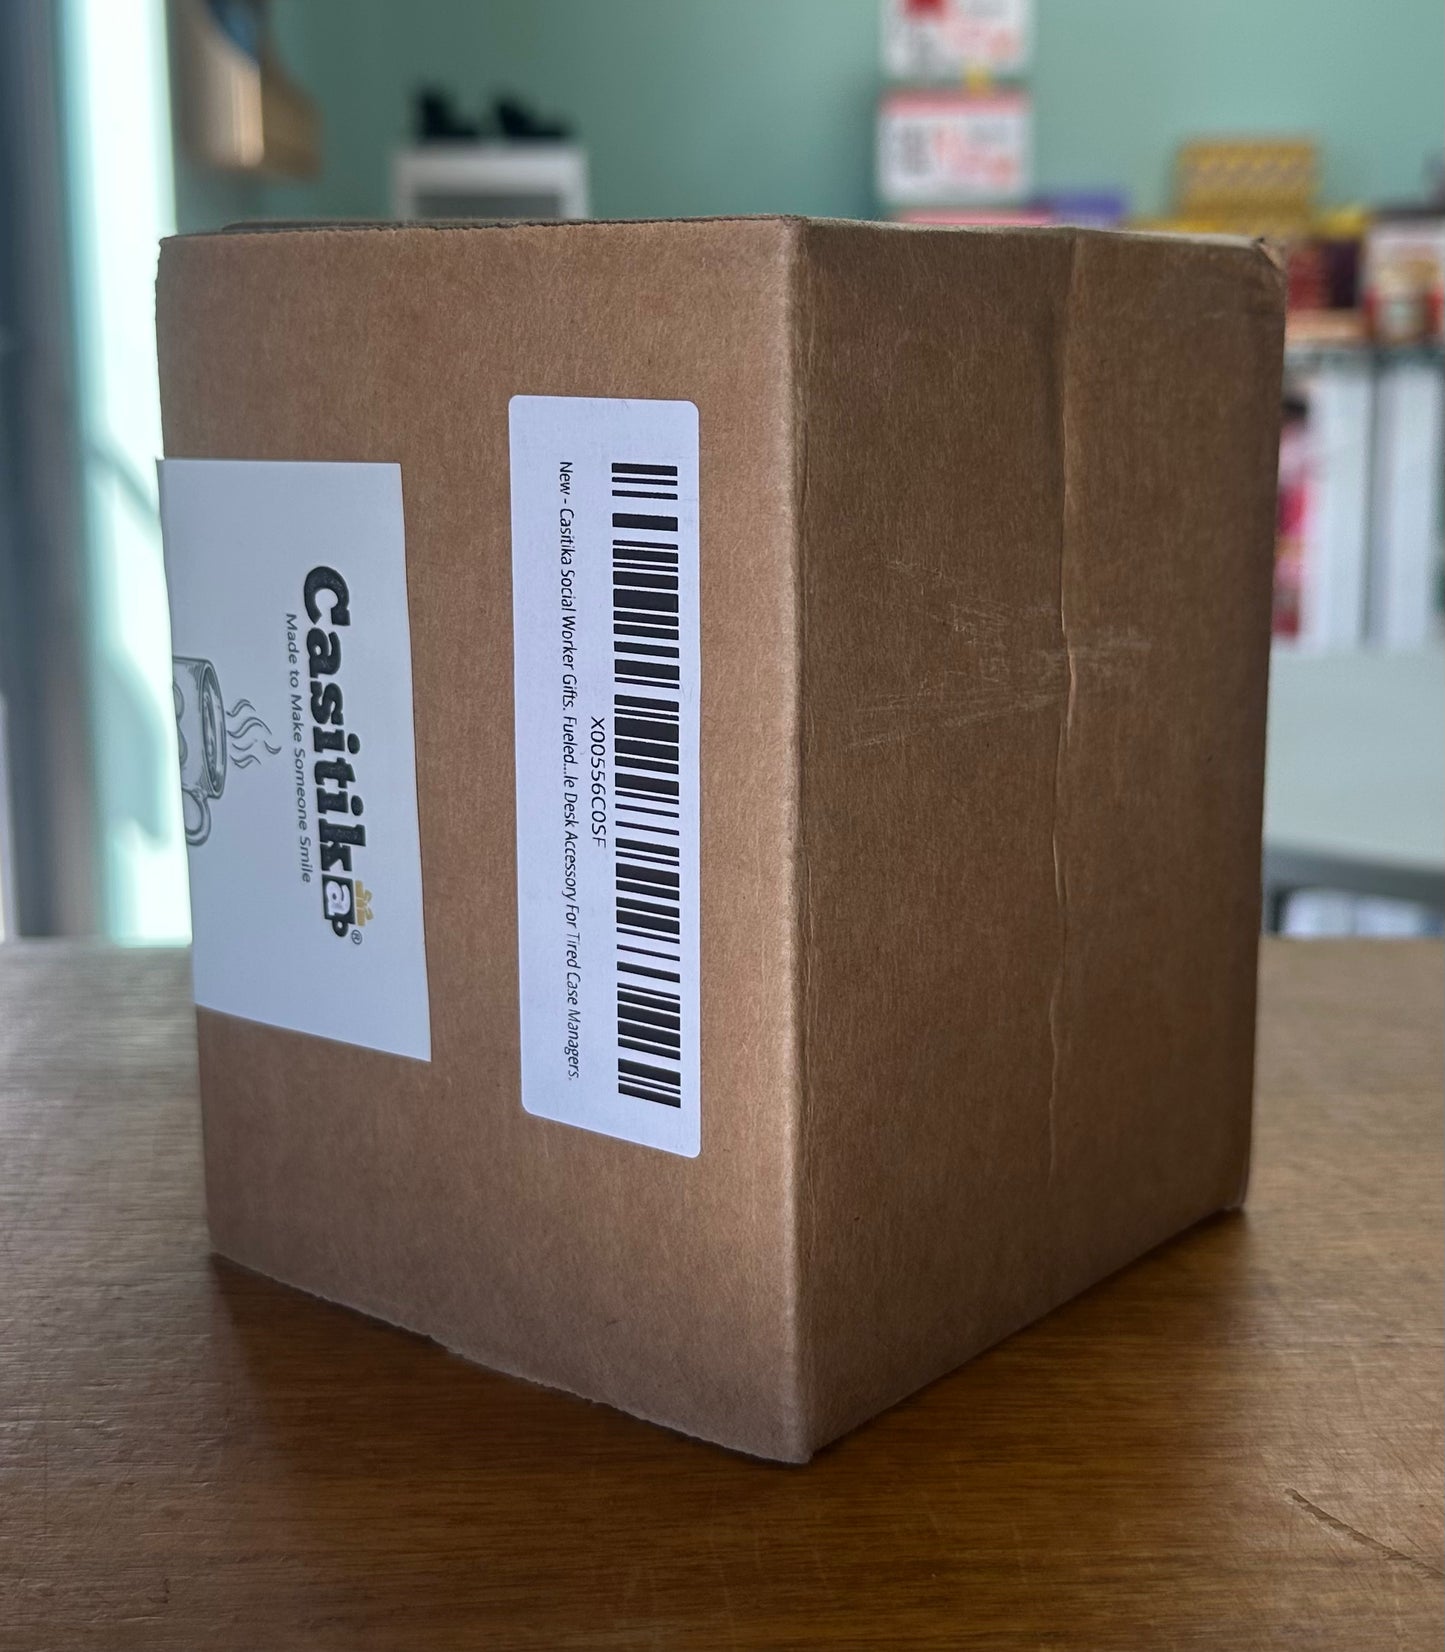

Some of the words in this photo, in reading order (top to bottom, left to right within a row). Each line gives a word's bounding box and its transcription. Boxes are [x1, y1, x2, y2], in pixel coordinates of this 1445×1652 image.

[559, 461, 574, 495] New
[560, 508, 575, 566] Casitika
[561, 568, 577, 612] Social
[286, 613, 300, 664] Made
[562, 616, 578, 670] Worker
[289, 669, 300, 688] to
[563, 674, 578, 711] Gifts.
[291, 694, 305, 743] Make
[294, 748, 308, 831] Someone
[590, 716, 607, 848] X00556C0SF
[564, 793, 580, 828] Desk
[299, 836, 314, 883] Smile
[562, 831, 579, 902] Accessory
[566, 904, 580, 929] For
[567, 933, 582, 969] Tired
[567, 972, 582, 1006] Case
[564, 1009, 582, 1081] Managers.
